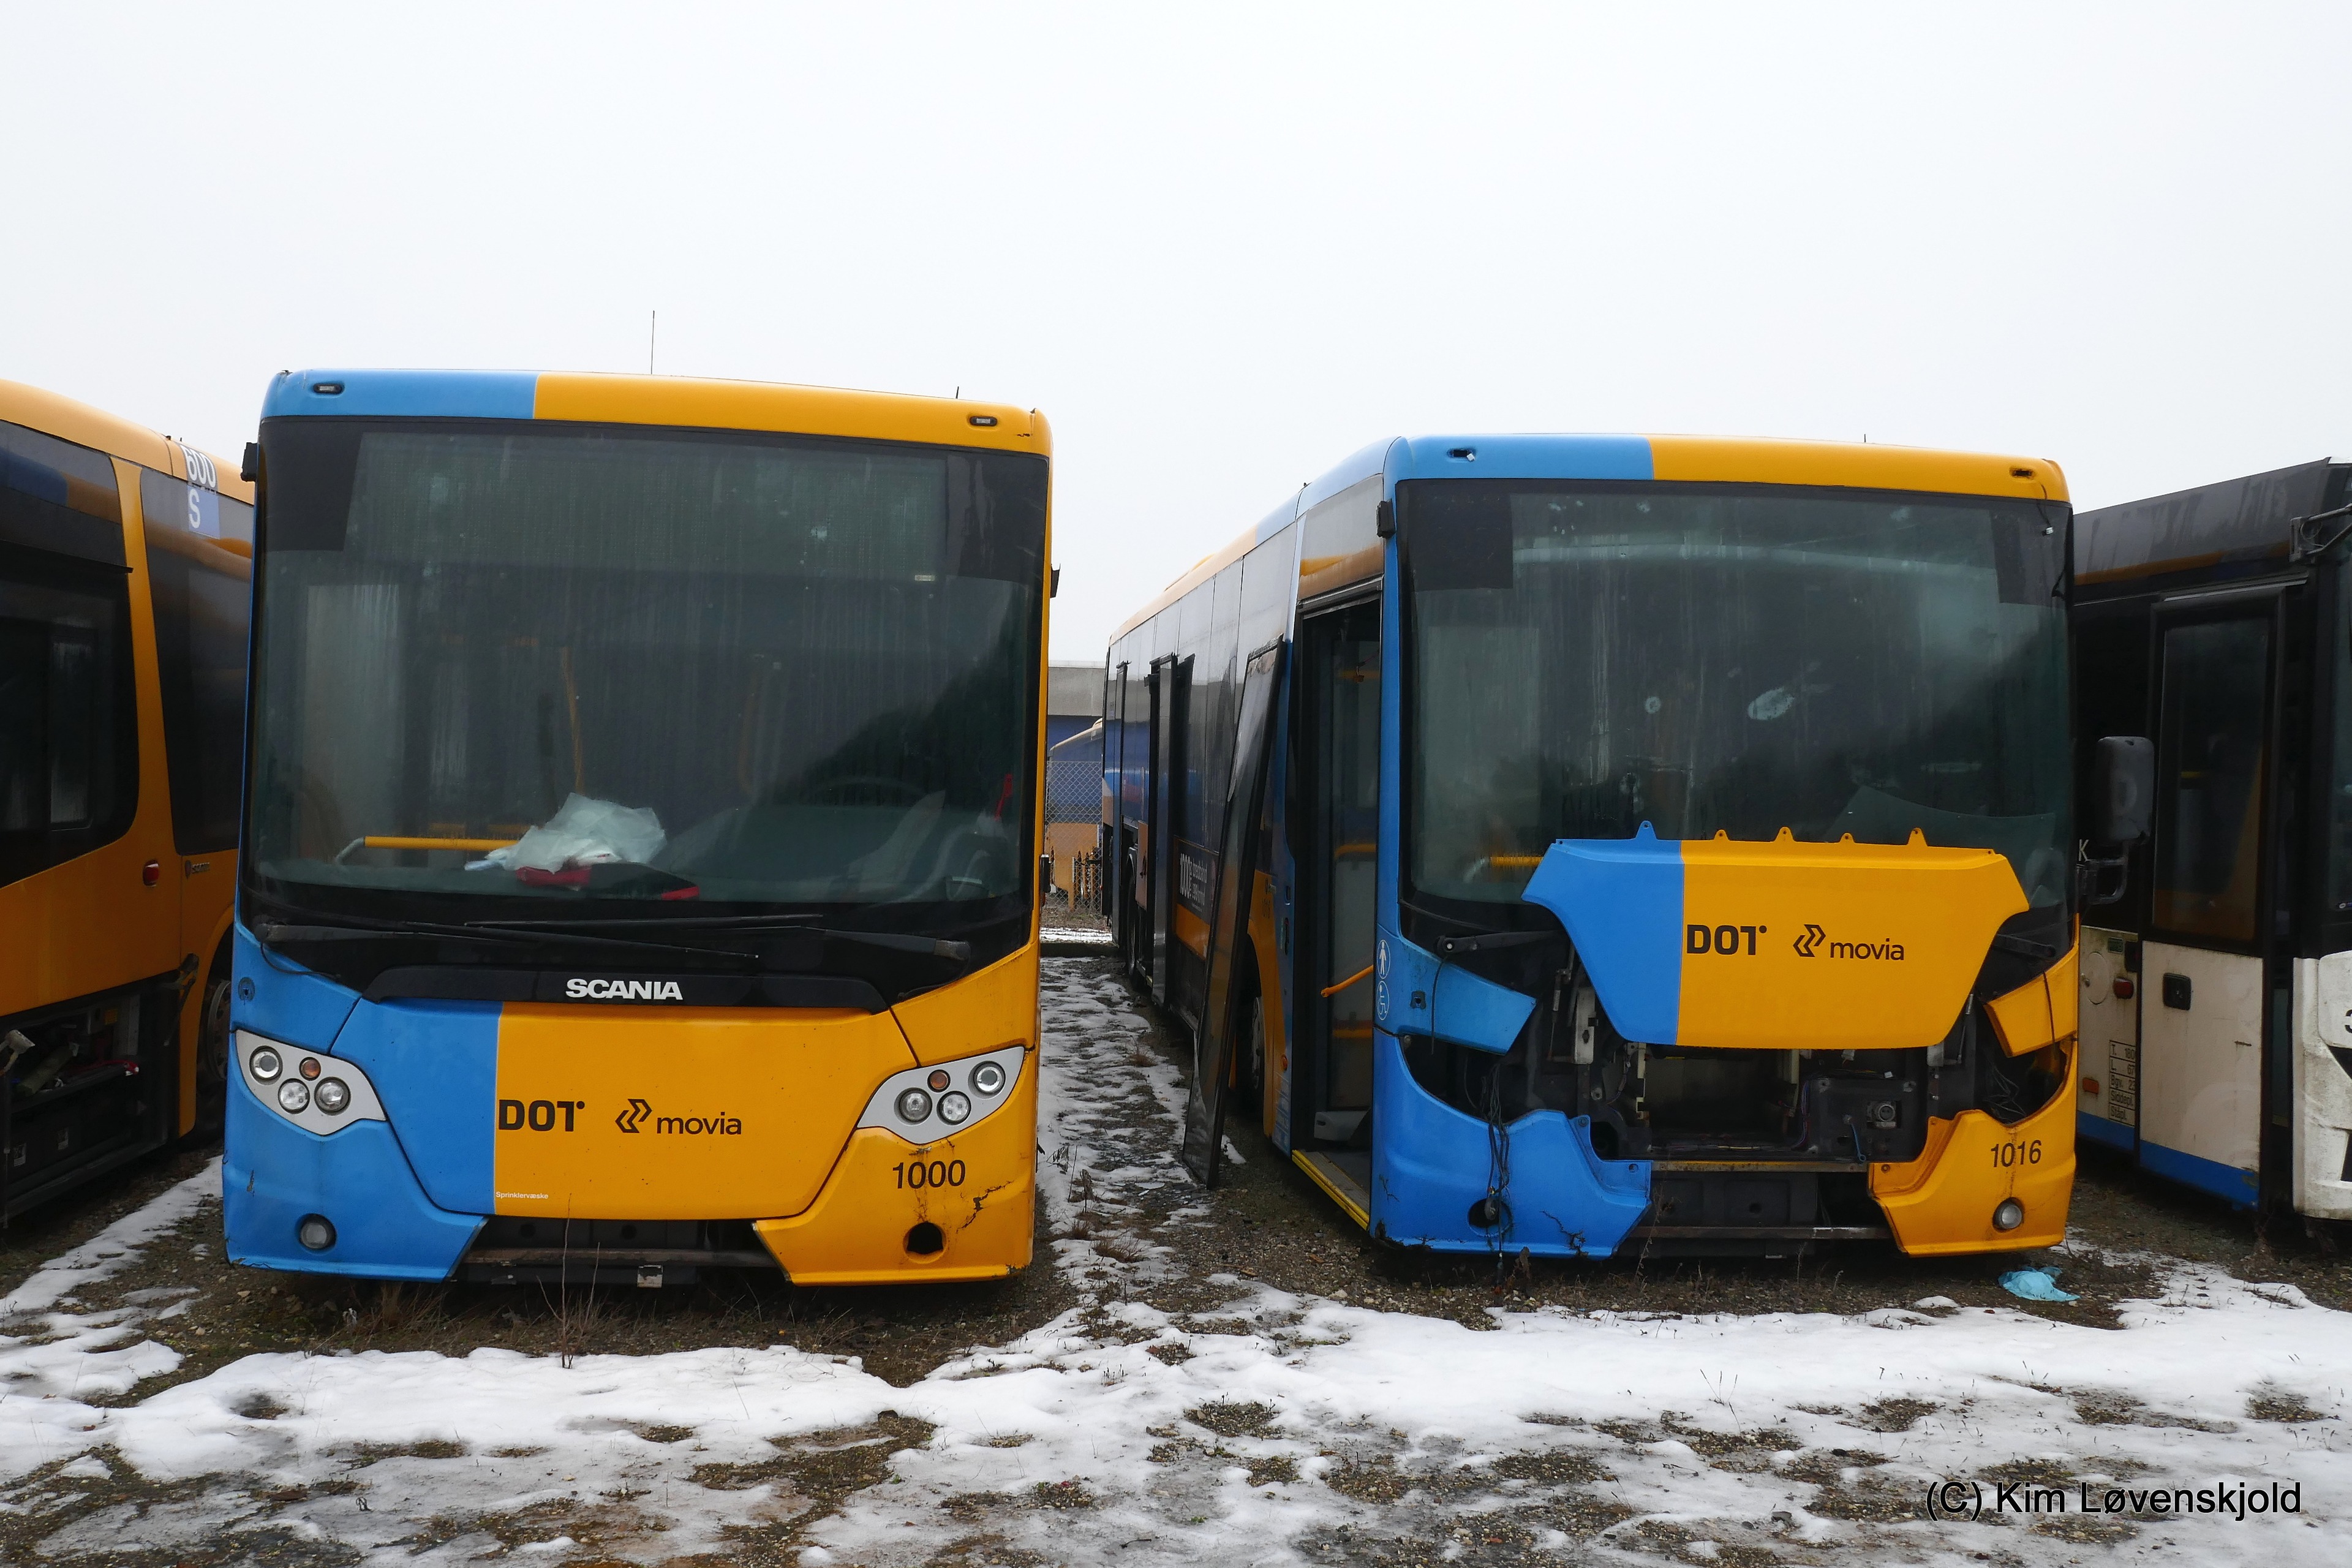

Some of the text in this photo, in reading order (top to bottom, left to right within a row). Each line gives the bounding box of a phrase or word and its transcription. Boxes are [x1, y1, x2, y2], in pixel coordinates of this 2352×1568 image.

[180, 445, 216, 488] 600
[189, 489, 201, 529] S
[1686, 924, 1904, 960] DOT movia
[565, 978, 684, 1000] SCANIA
[498, 1099, 742, 1135] DOT movia
[1990, 1140, 2041, 1167] 1016
[892, 1159, 966, 1189] 1000
